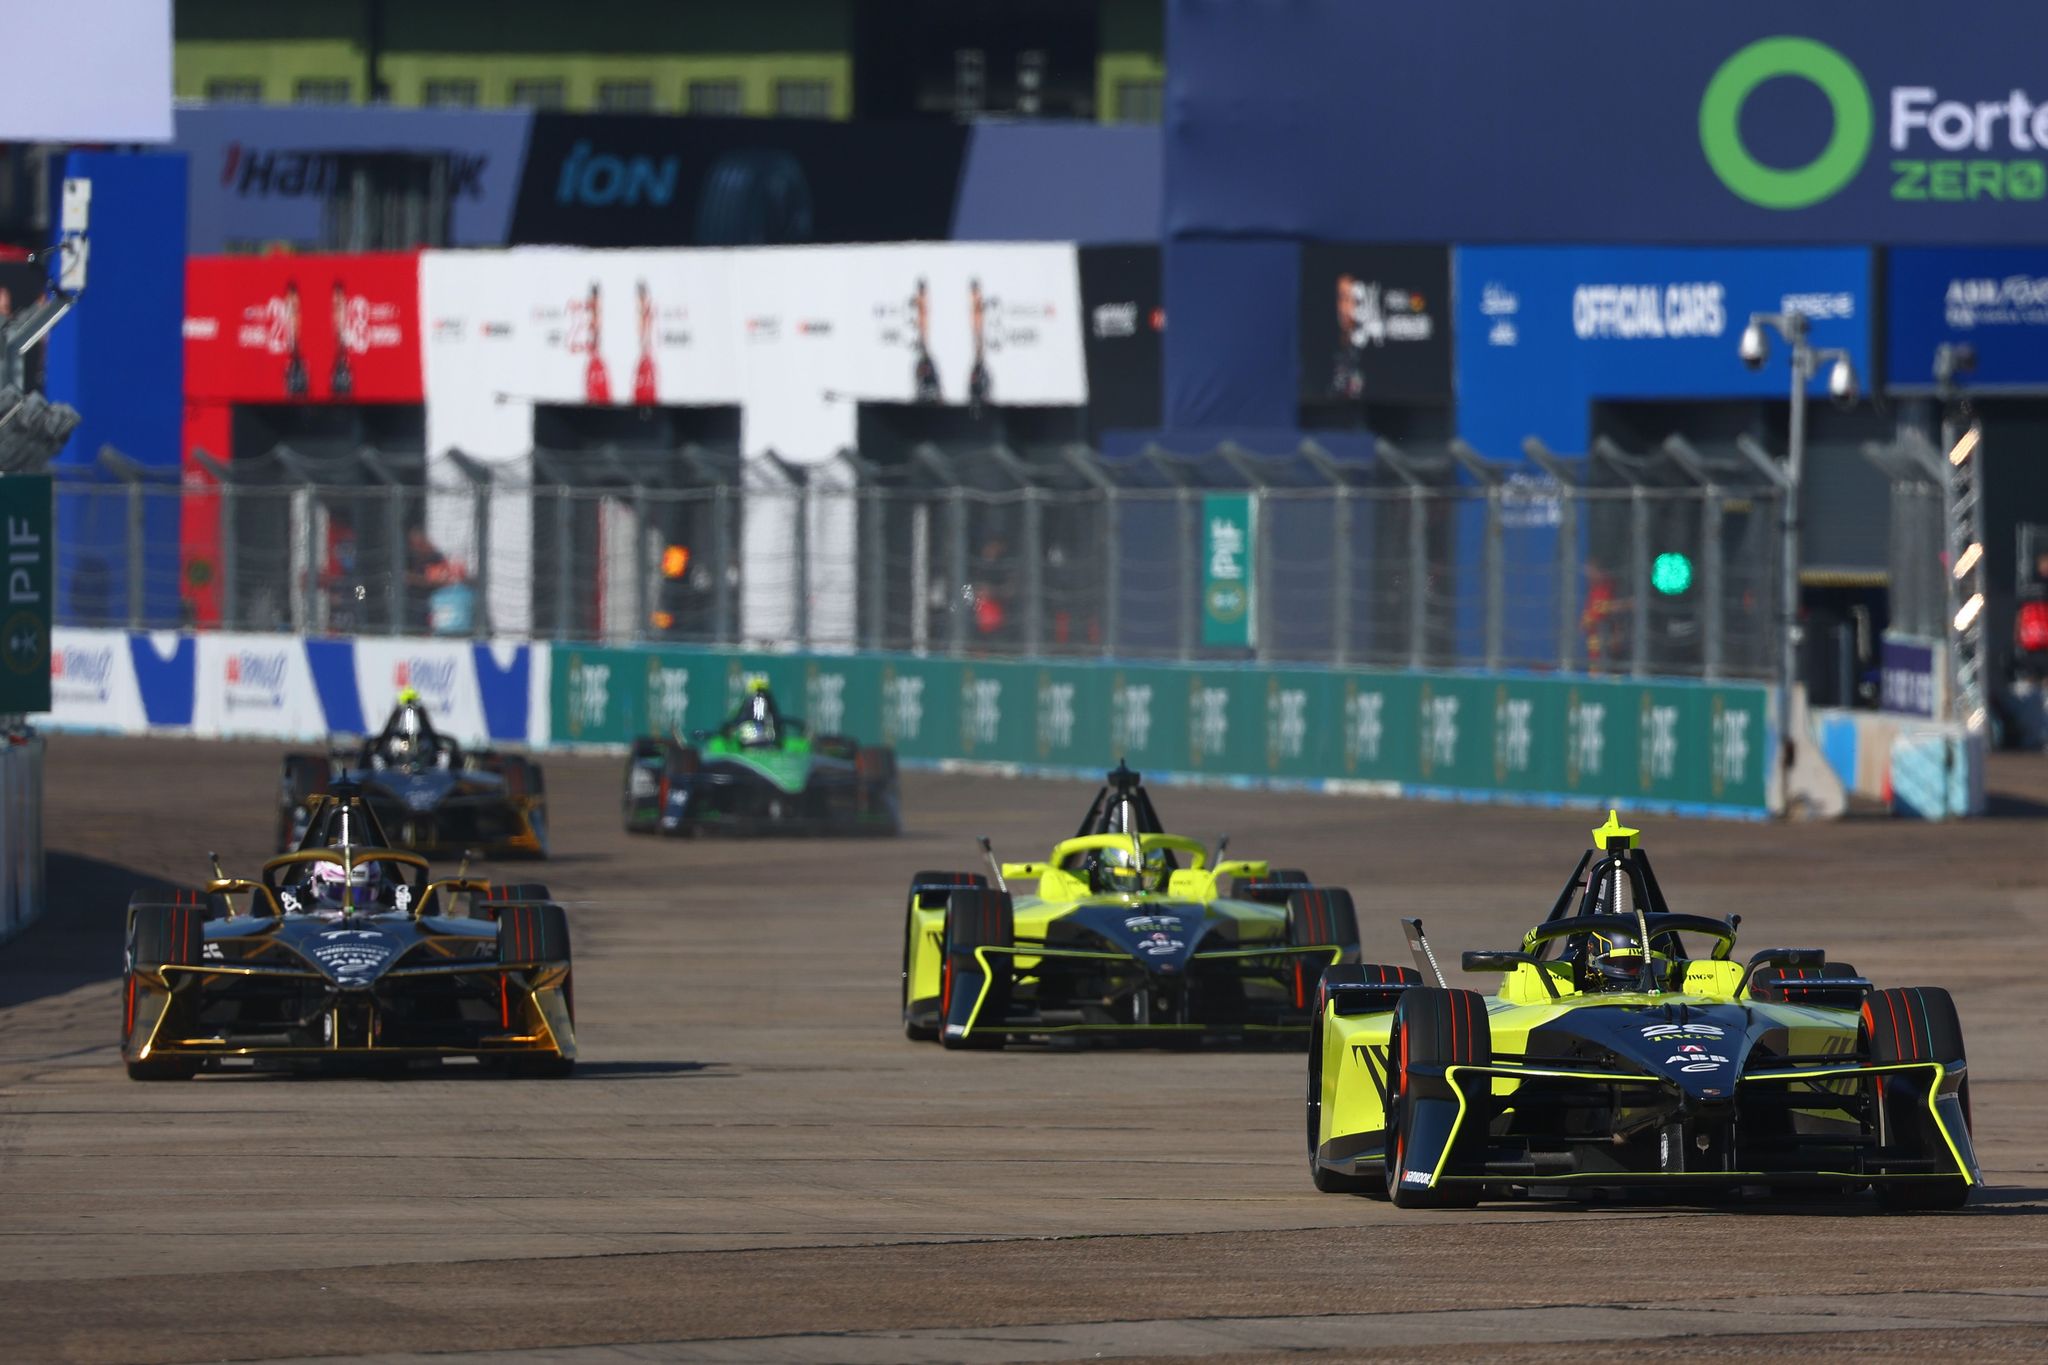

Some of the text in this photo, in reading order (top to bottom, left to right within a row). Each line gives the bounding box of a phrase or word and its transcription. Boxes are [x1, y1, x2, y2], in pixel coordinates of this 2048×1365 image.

[1573, 284, 1664, 338] OFFICIAL
[1664, 282, 1726, 336] CARS
[8, 515, 41, 602] PIF
[1640, 1024, 1726, 1037] 28
